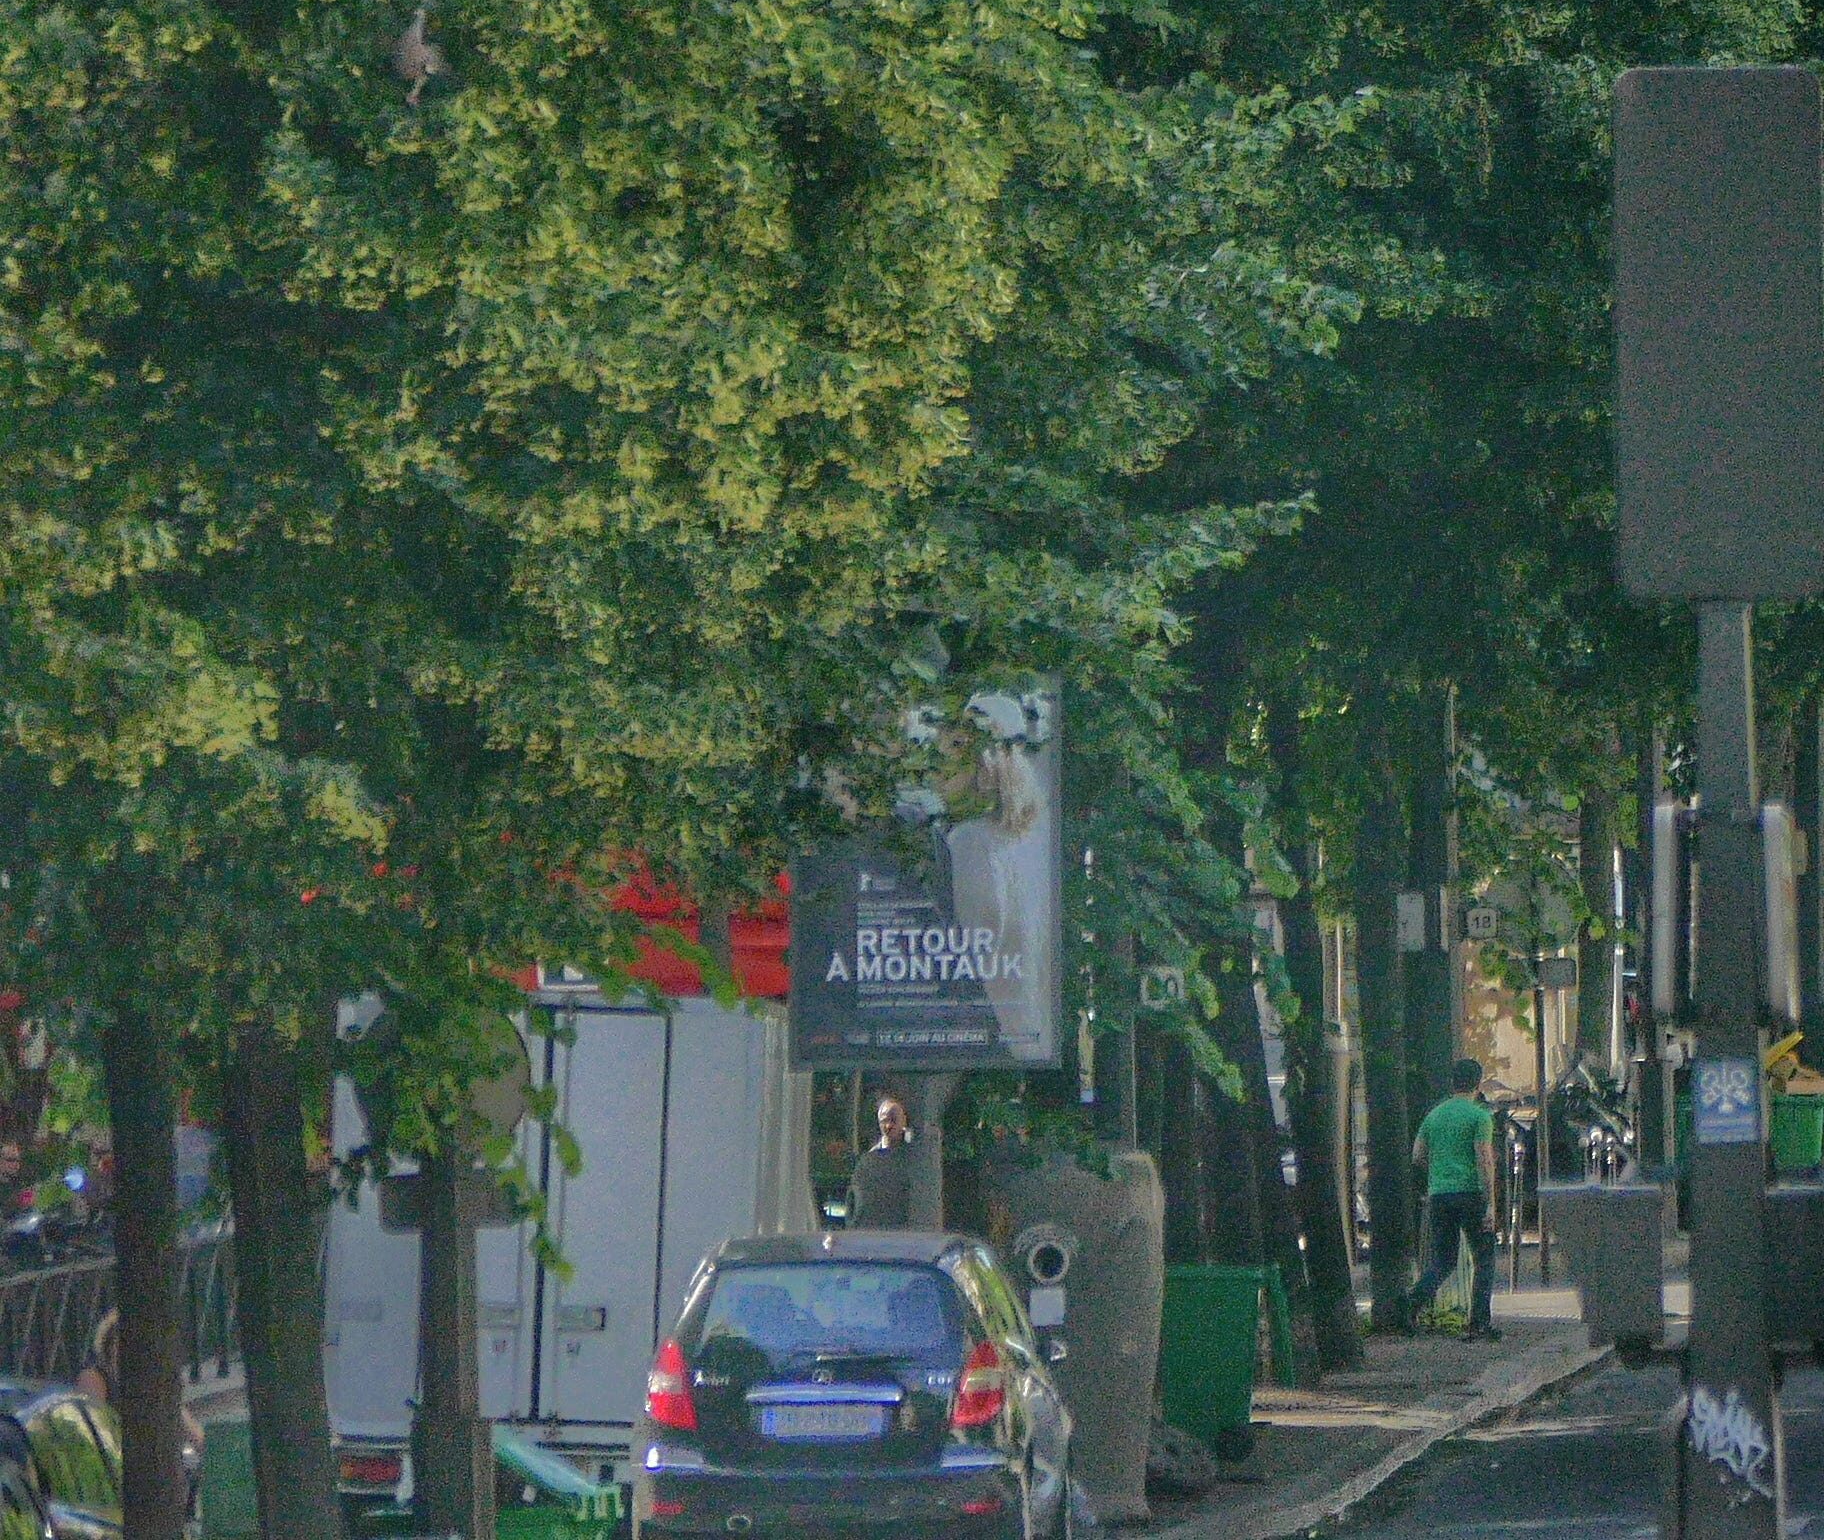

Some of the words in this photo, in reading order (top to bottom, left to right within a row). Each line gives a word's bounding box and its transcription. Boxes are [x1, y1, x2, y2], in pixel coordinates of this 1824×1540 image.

[857, 927, 994, 956] RETOUR
[826, 951, 849, 982] À
[857, 954, 1022, 982] MONTAUK
